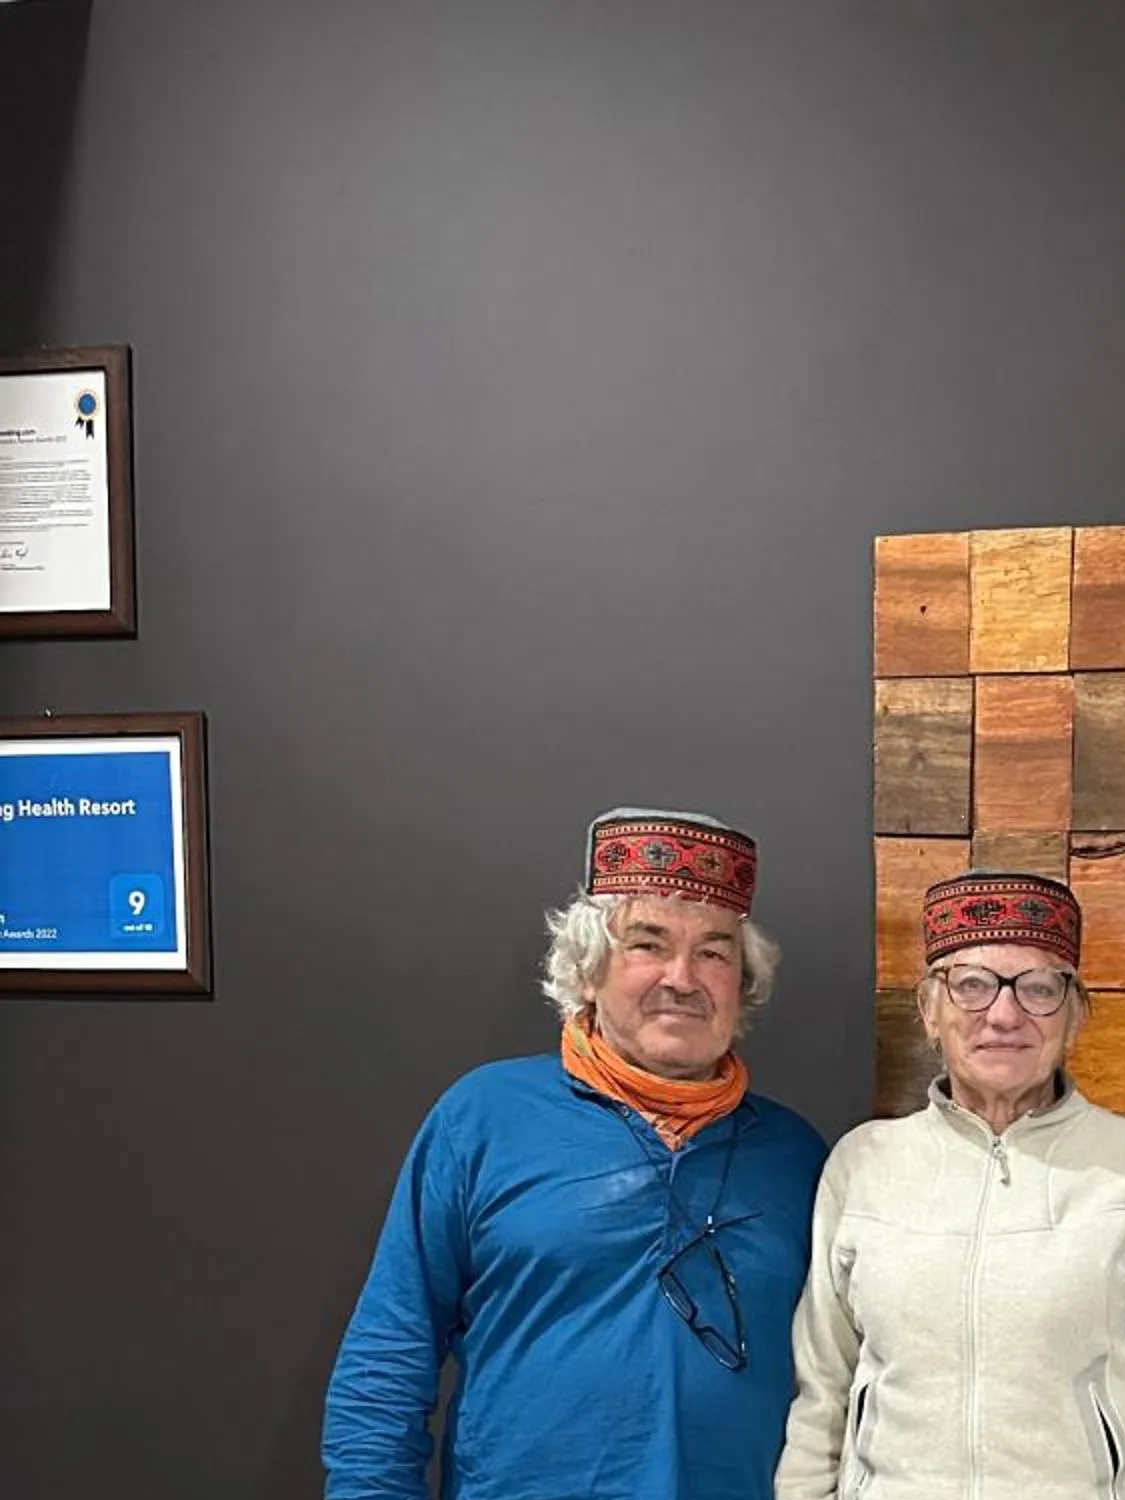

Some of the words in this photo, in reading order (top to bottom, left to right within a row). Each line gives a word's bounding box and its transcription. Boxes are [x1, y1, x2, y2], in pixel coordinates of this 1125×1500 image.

[18, 797, 75, 817] Health
[79, 798, 136, 815] Resort
[128, 890, 145, 916] 9
